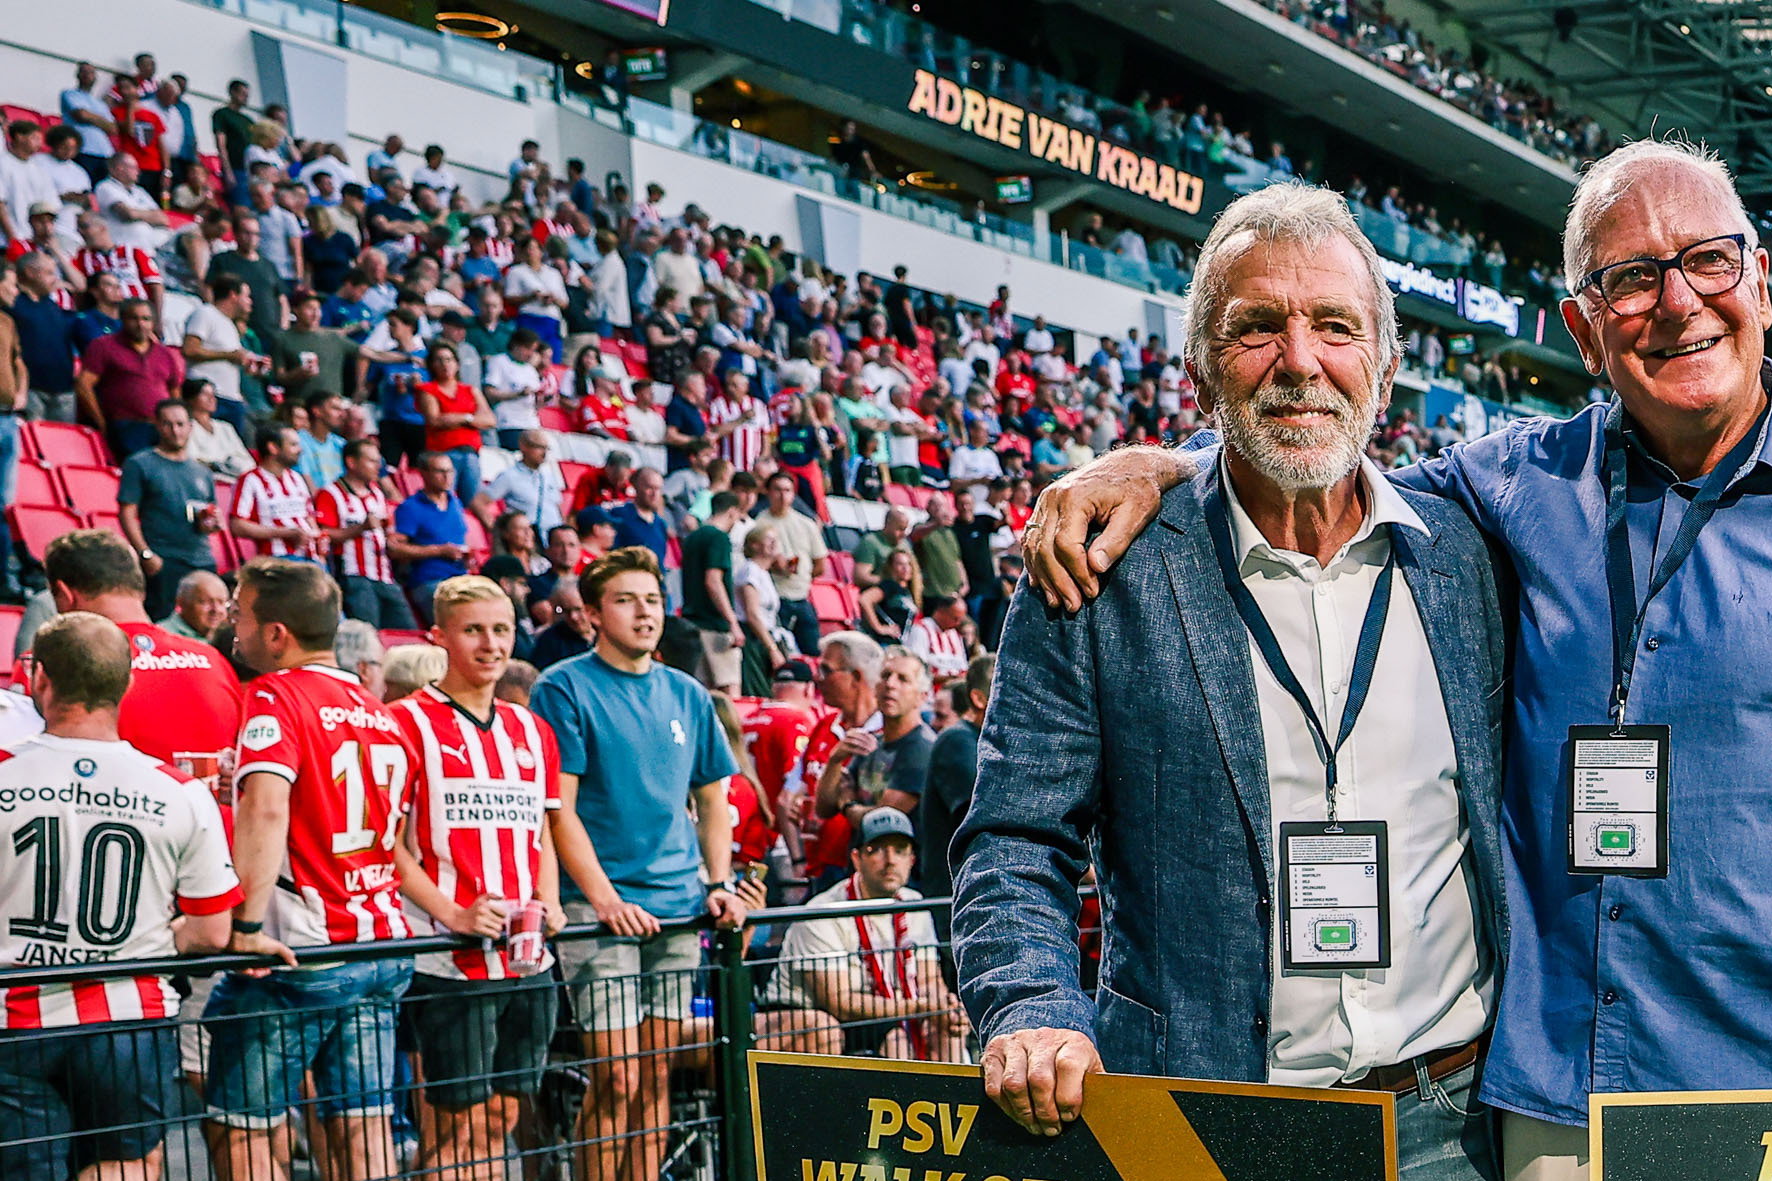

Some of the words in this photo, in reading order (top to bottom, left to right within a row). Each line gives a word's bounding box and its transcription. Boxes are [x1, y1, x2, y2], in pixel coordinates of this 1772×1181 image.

[908, 68, 1025, 150] ADRIE
[1027, 111, 1096, 176] VAN
[1097, 139, 1205, 216] KRAAIJ
[0, 782, 168, 817] goodhabitz
[331, 740, 409, 855] 17
[9, 815, 146, 947] 10
[868, 1098, 980, 1156] PSV
